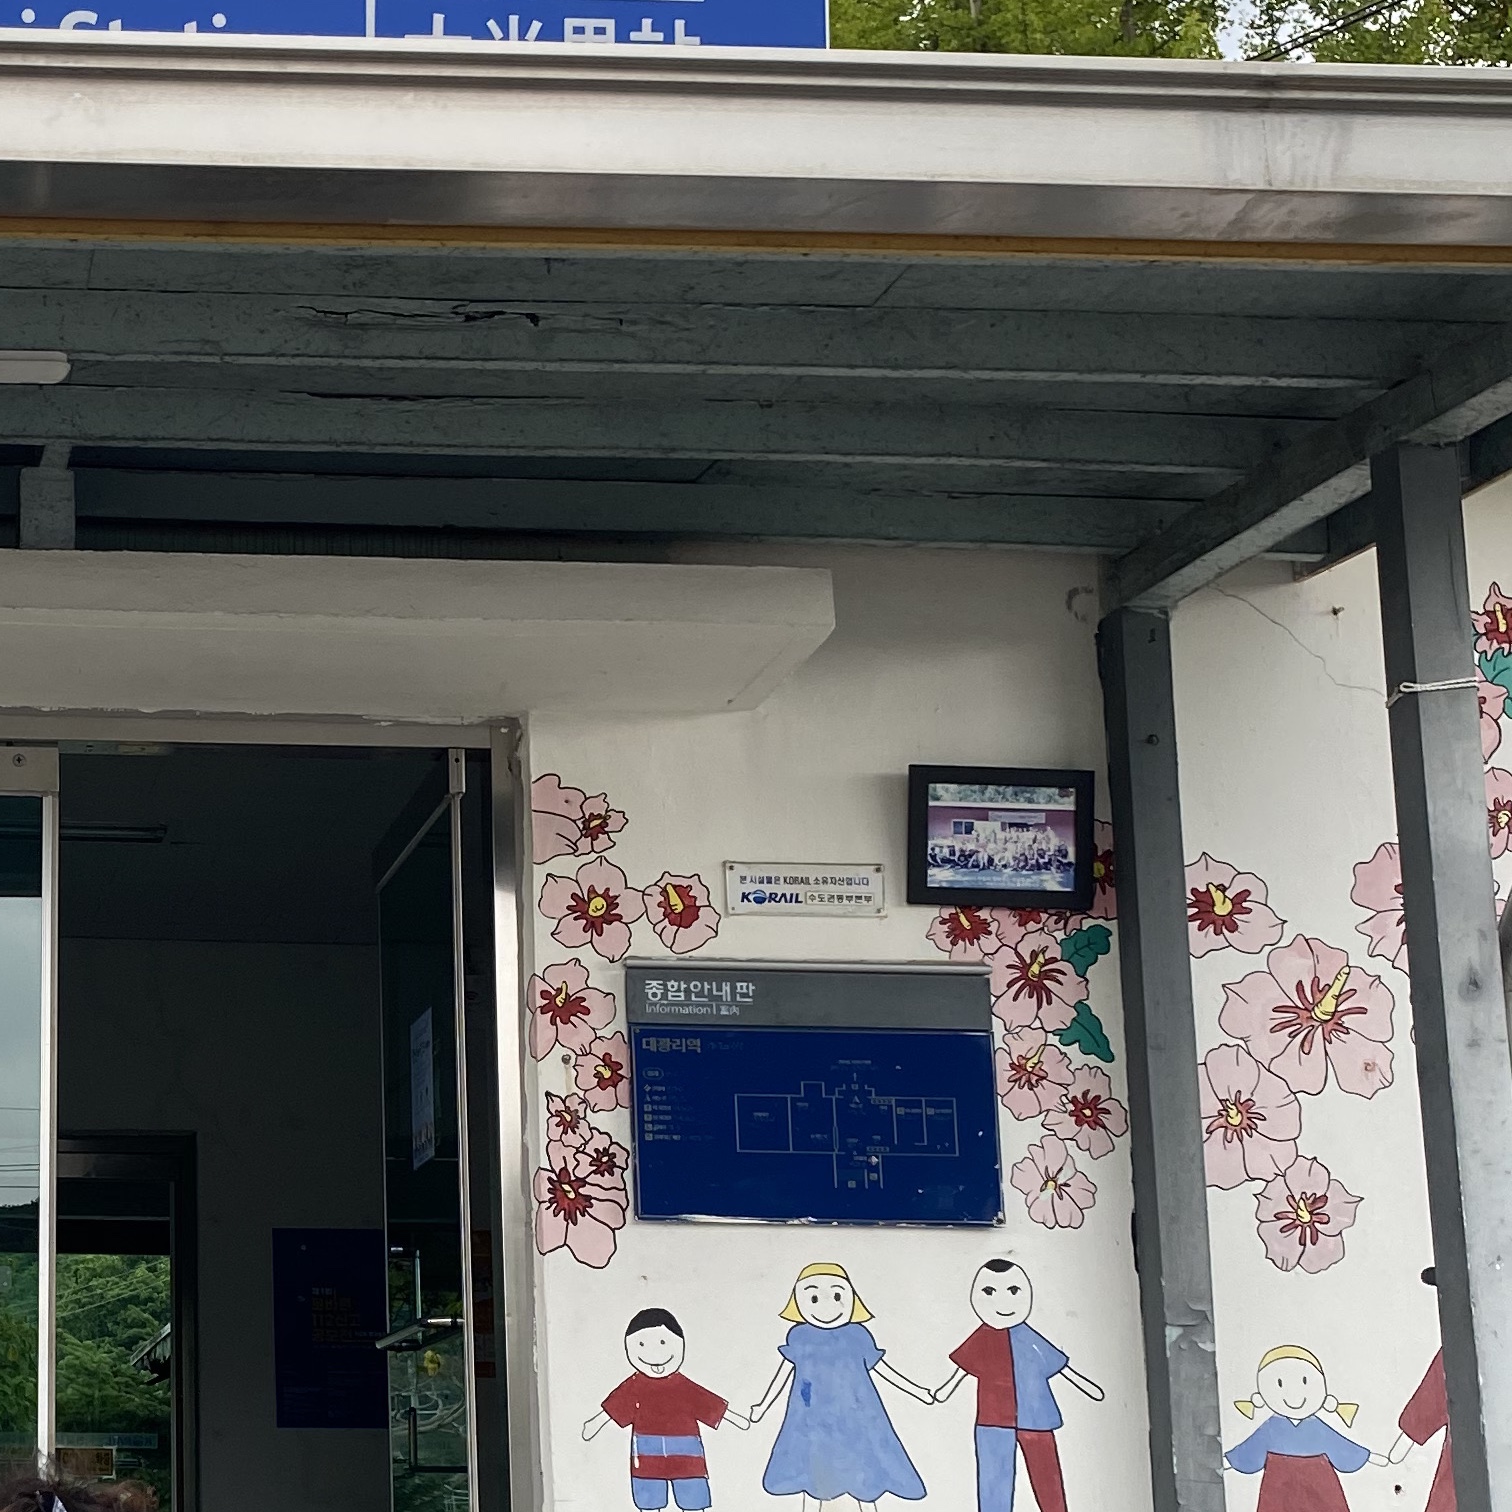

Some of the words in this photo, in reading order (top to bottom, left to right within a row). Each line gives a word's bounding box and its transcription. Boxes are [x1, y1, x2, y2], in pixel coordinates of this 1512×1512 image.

[749, 875, 781, 886] 시설물은
[783, 876, 812, 886] KORAIL
[813, 876, 870, 887] 소유자산입니다
[740, 889, 804, 905] KORAIL
[644, 979, 756, 1002] 종합안내판
[645, 1003, 711, 1015] Information
